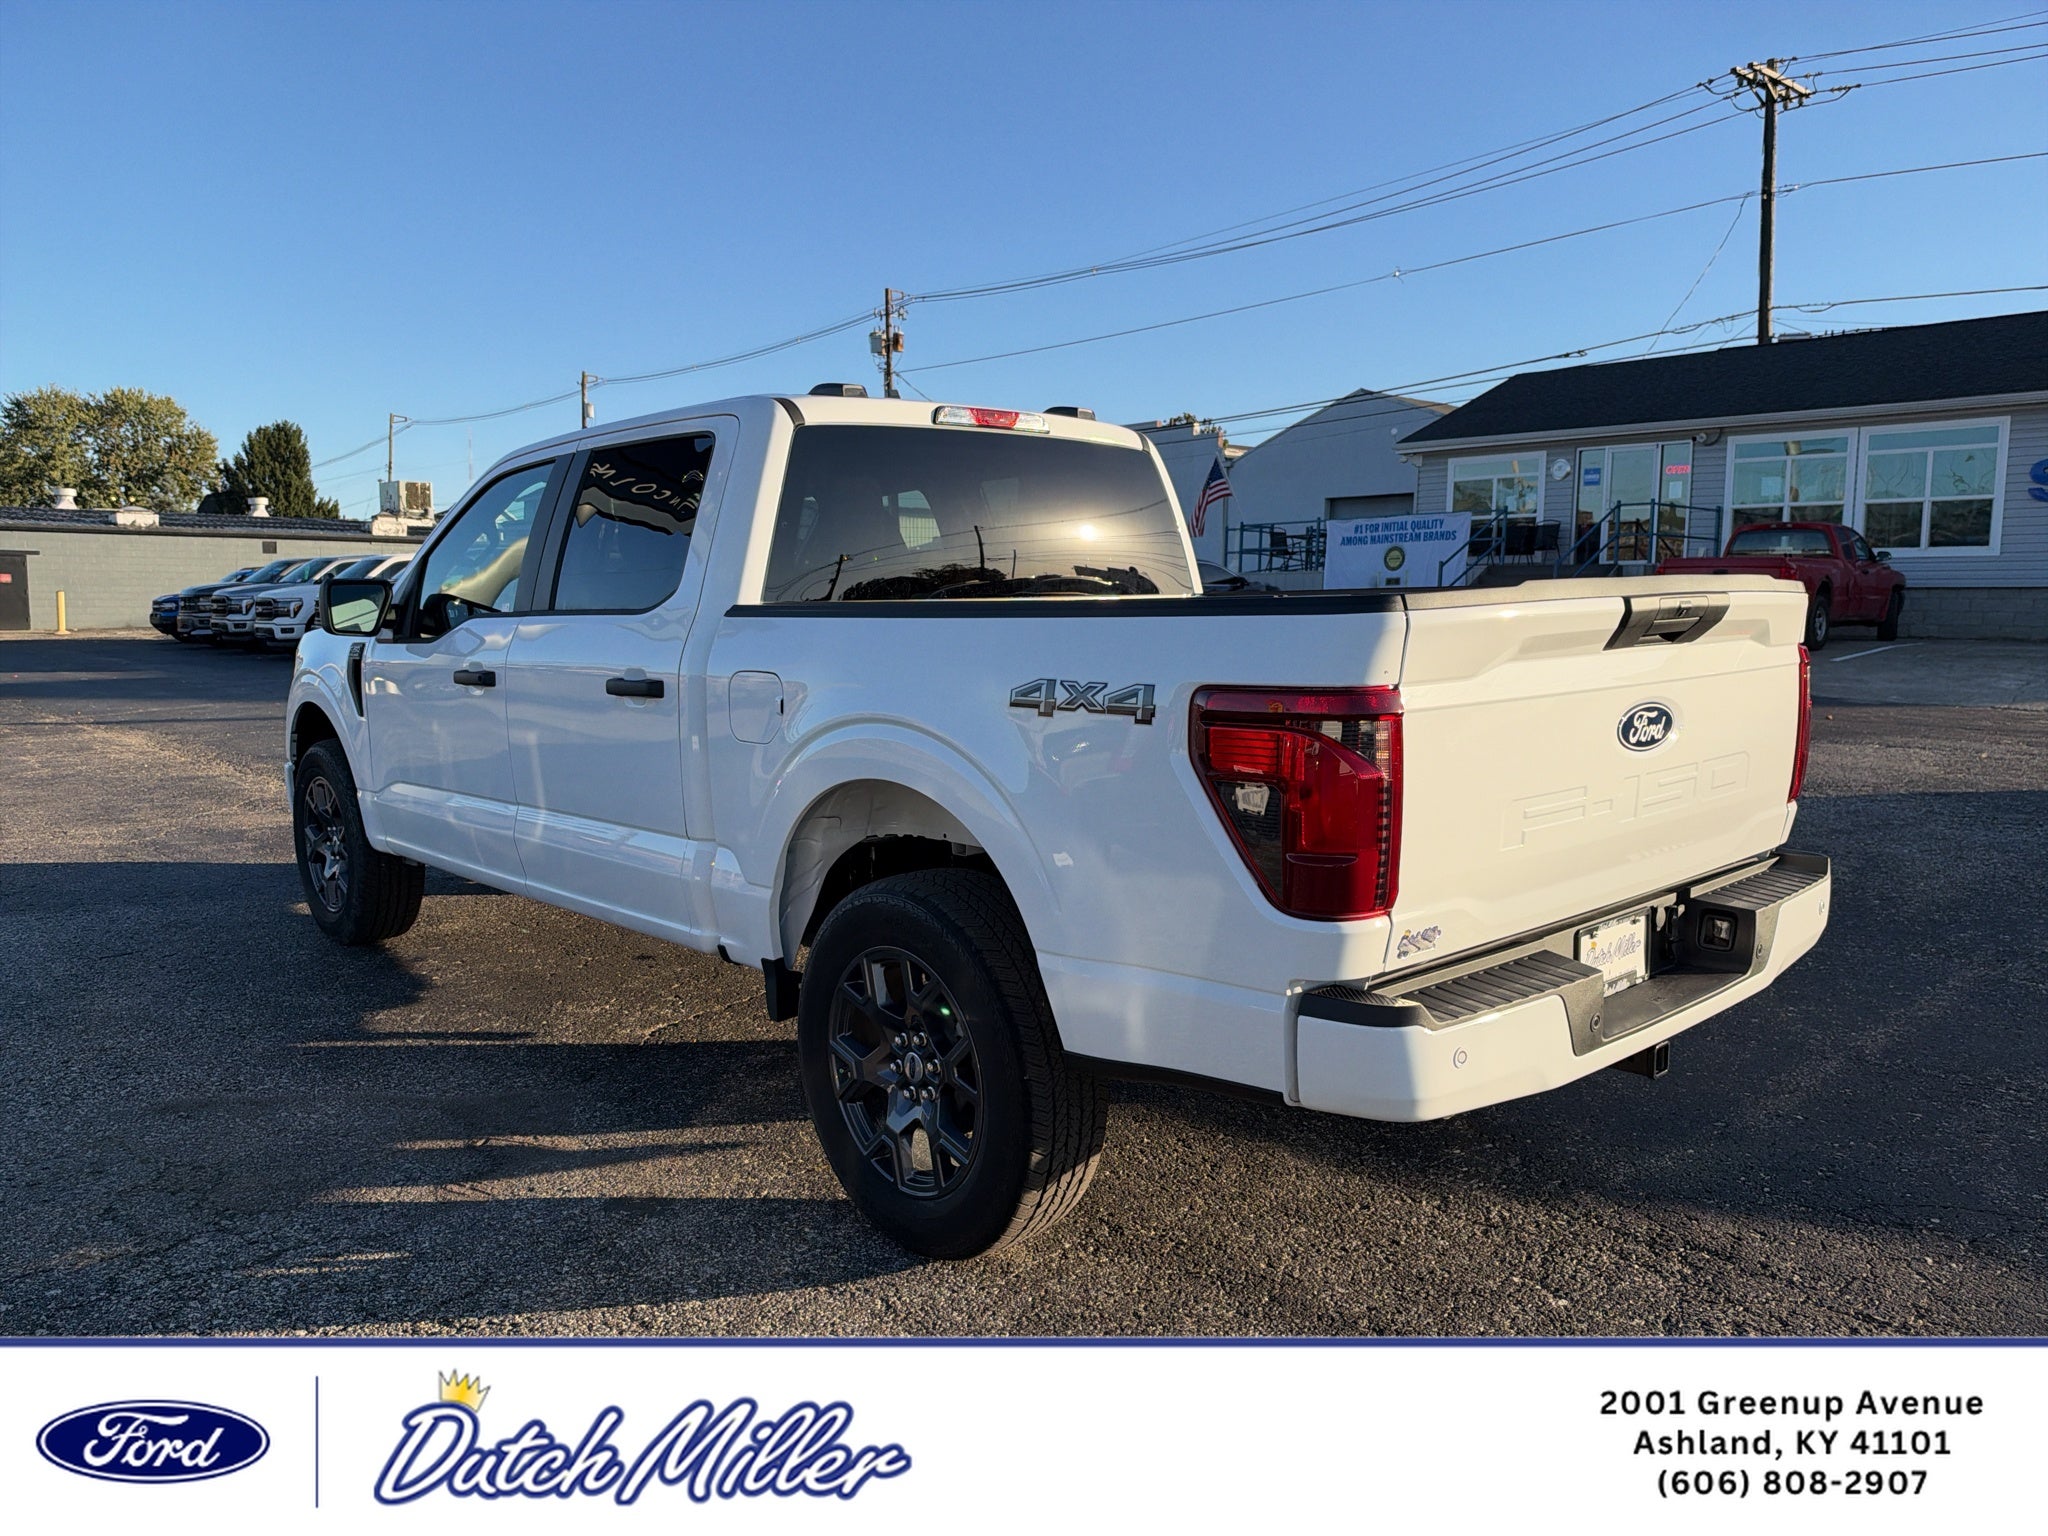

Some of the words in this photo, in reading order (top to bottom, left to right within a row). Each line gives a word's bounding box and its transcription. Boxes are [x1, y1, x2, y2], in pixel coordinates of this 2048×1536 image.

[1665, 464, 1691, 475] OPEN
[1353, 524, 1363, 535] #1
[1365, 523, 1380, 534] FOR
[1381, 520, 1409, 533] INITIAL
[1410, 518, 1445, 532] QUALITY
[1339, 534, 1369, 546] AMONG
[1369, 531, 1421, 545] MAINSTREAM
[1422, 530, 1457, 541] BRANDS
[1629, 710, 1666, 744] Ford
[1499, 750, 1751, 853] F-150
